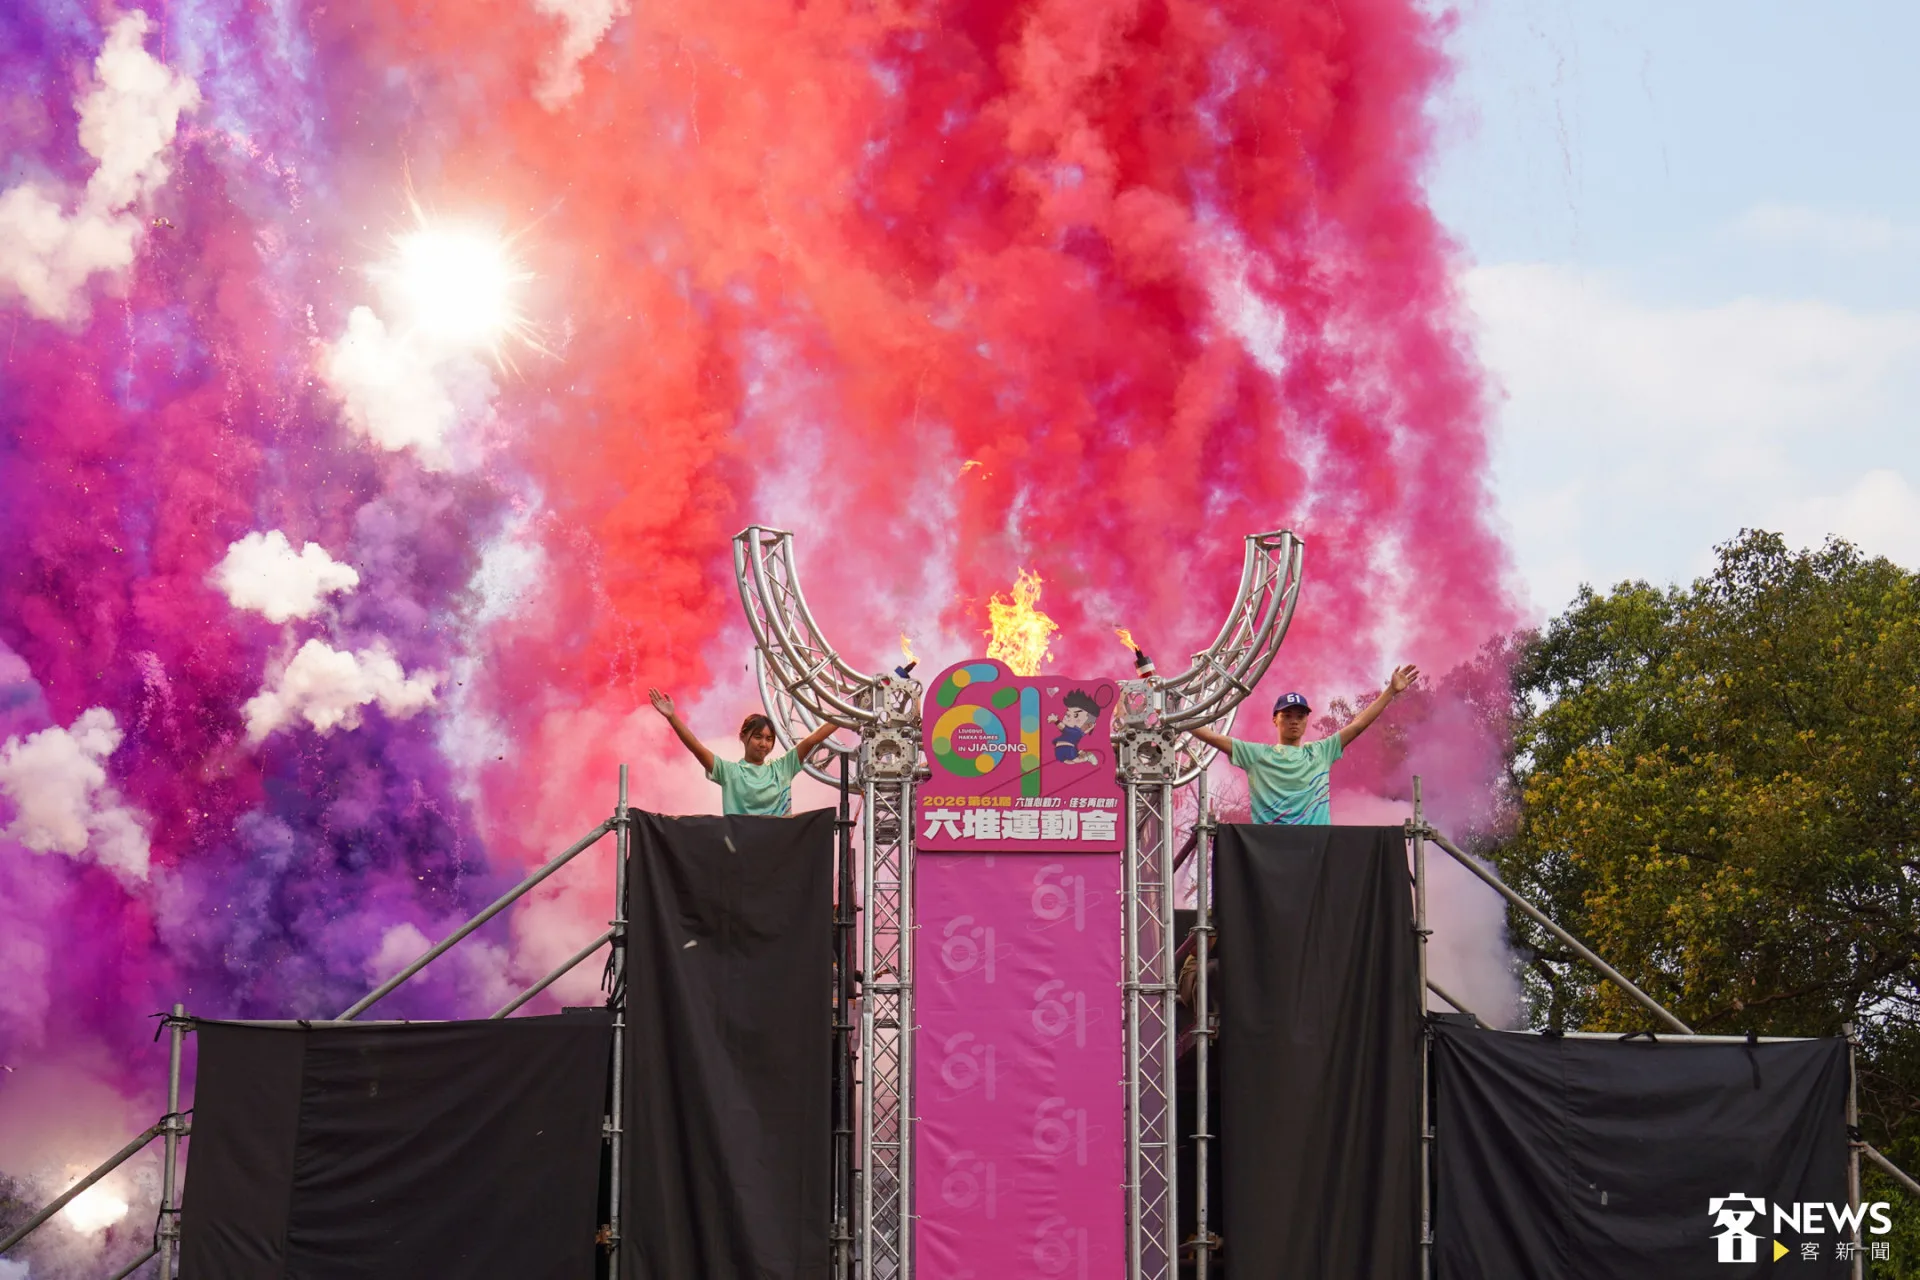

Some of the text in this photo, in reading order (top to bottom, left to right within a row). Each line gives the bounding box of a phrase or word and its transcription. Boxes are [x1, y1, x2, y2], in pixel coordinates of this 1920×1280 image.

[1286, 693, 1301, 704] 61
[932, 663, 1040, 798] 61
[967, 743, 1027, 752] JIADONG
[922, 796, 966, 806] 2026
[923, 808, 1118, 841] 六堆運動會
